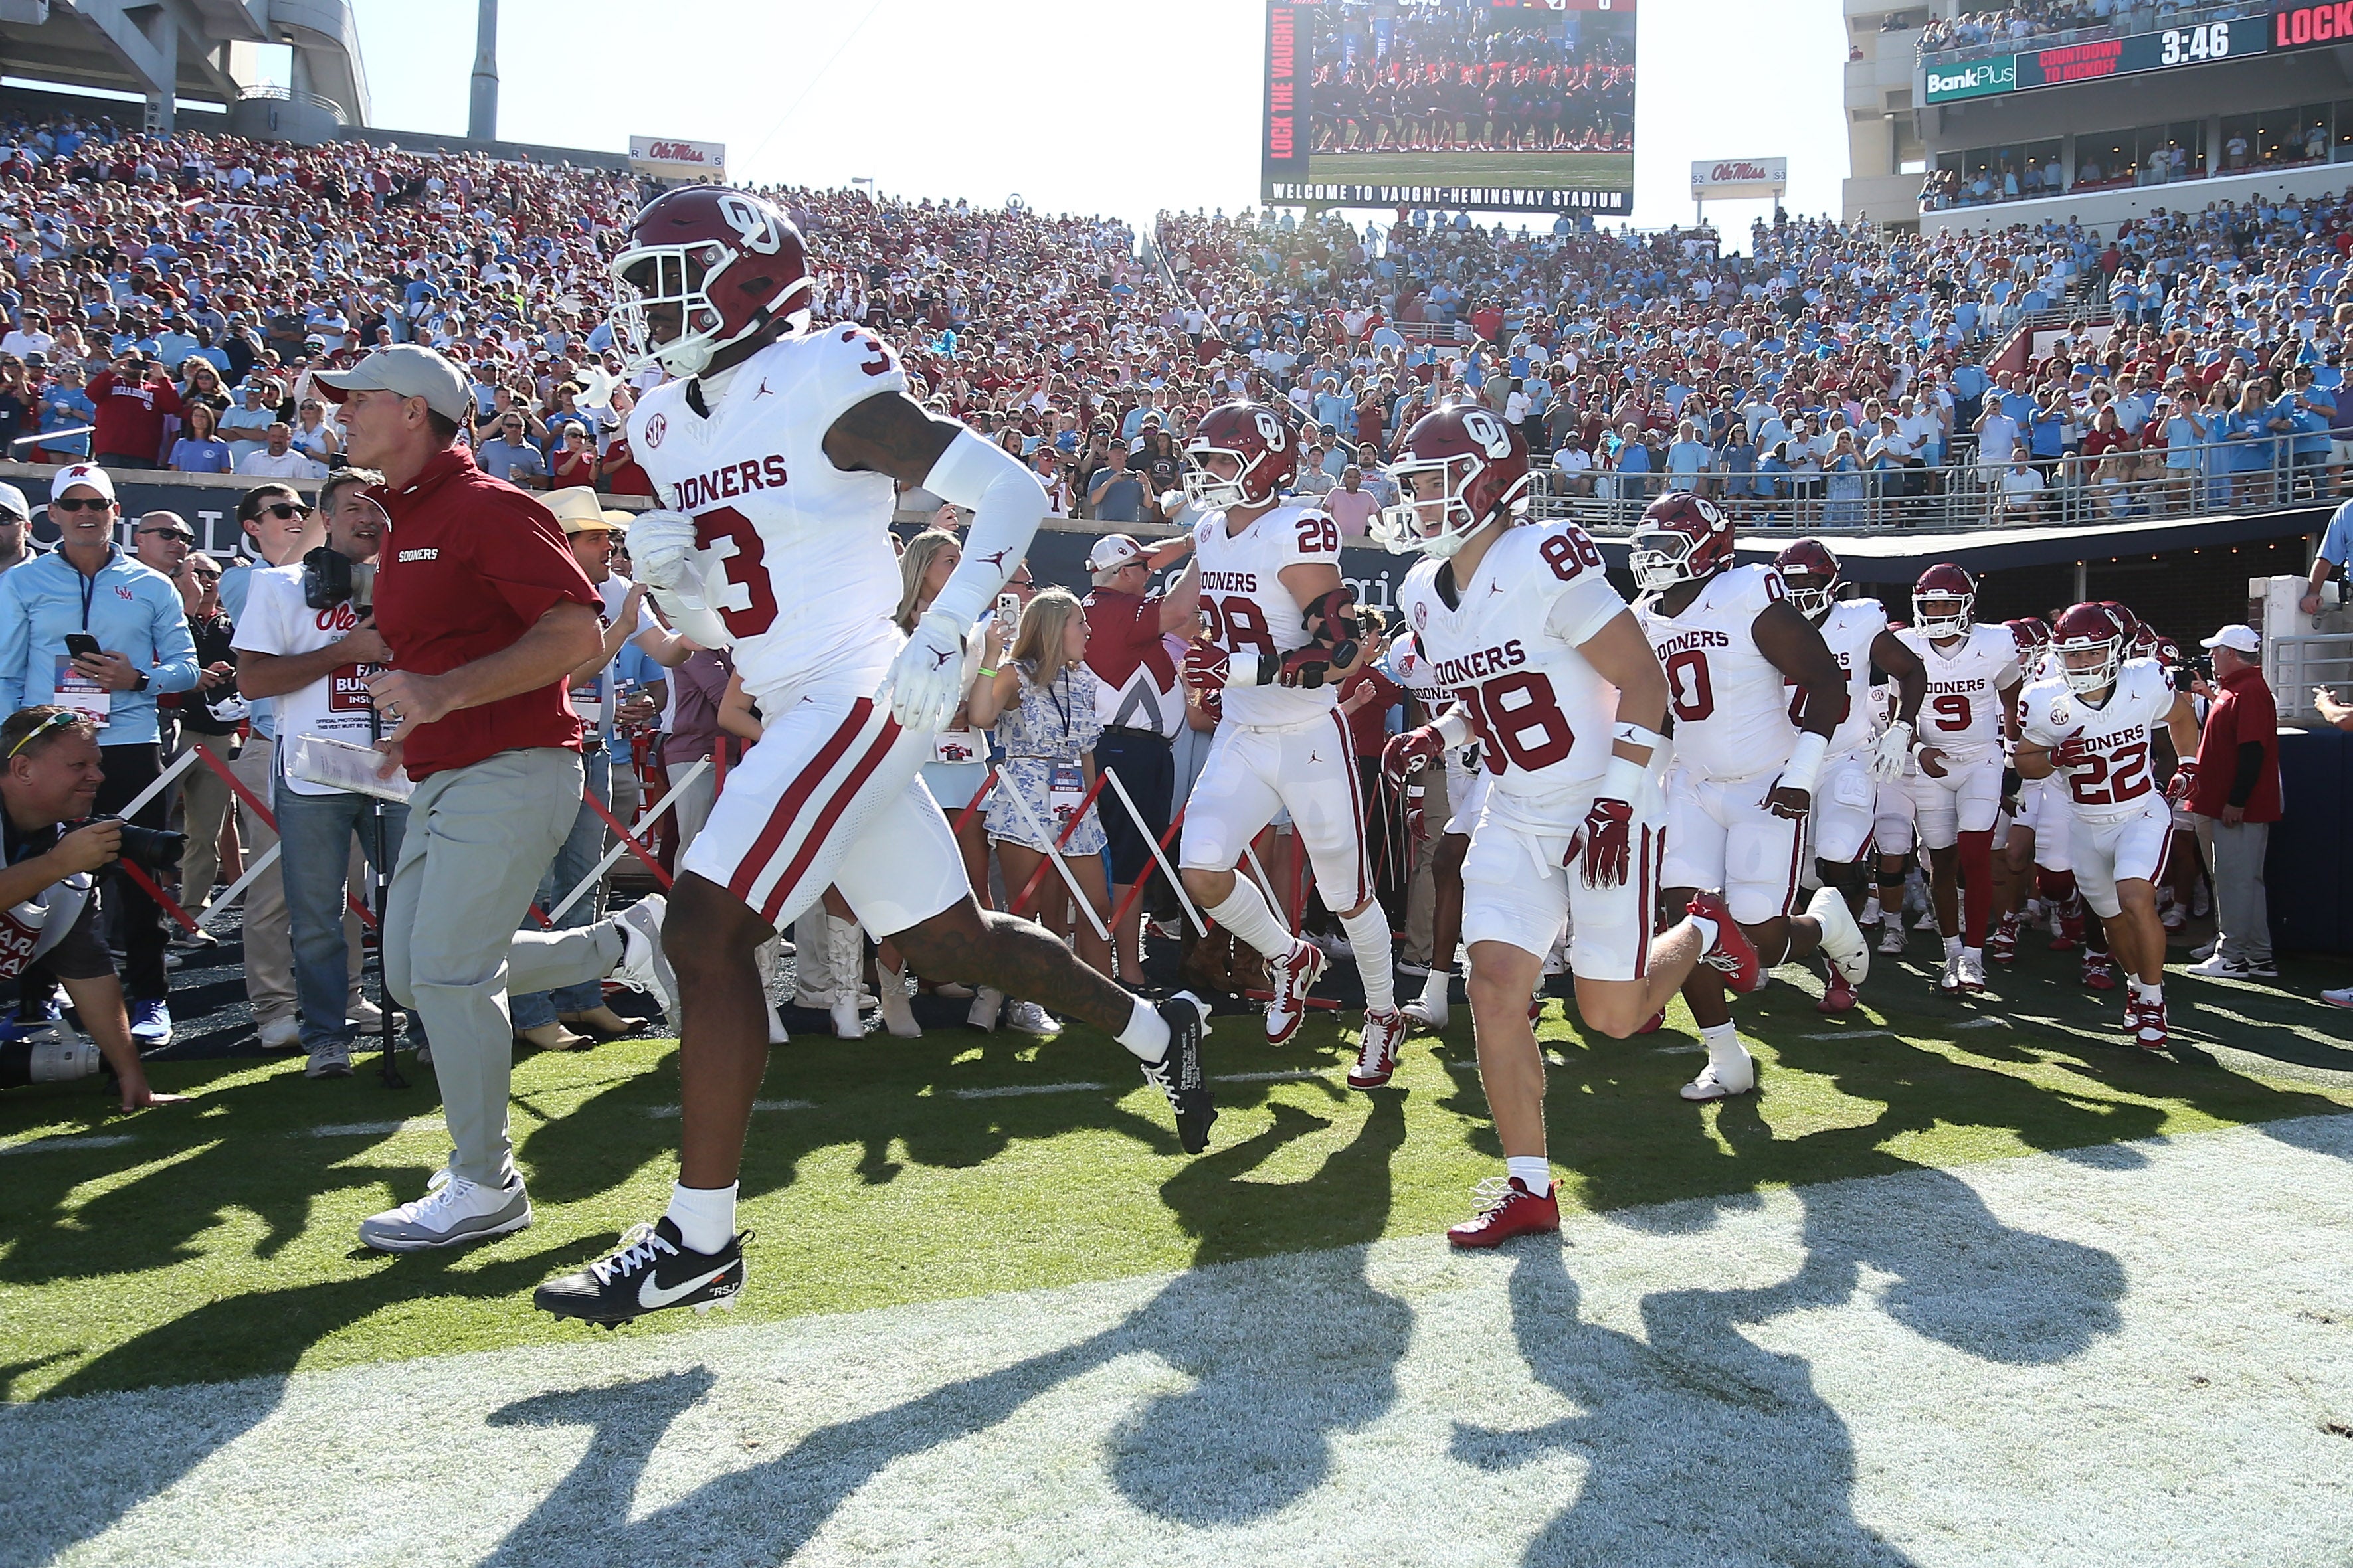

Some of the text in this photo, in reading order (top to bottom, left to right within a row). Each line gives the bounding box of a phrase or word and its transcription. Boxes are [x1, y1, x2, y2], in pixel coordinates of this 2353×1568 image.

[2276, 1, 2353, 46] LOCK
[2039, 40, 2122, 67] COUNTDOWN
[2161, 23, 2229, 65] 3:46
[1270, 8, 1295, 159] LOCK THE VAUGHT!
[1927, 65, 2014, 94] BankPlus
[2043, 57, 2117, 84] TO KICKOFF
[631, 149, 639, 159] R
[649, 141, 704, 163] Ole Miss
[713, 157, 722, 166] S
[1711, 162, 1766, 181] Ole Miss
[1271, 182, 1622, 209] WELCOME TO VAUGHT-HEMINGWAY STADIUM
[1771, 286, 1784, 296] 24
[842, 329, 890, 377] 3
[1295, 517, 1339, 553] 28
[398, 547, 439, 563] SOONERS
[1539, 527, 1602, 582] 88
[692, 505, 780, 640] 3
[1657, 630, 1729, 661] OONERS
[1667, 649, 1715, 723] 0
[1932, 694, 1973, 732] 9
[2069, 741, 2153, 805] 22
